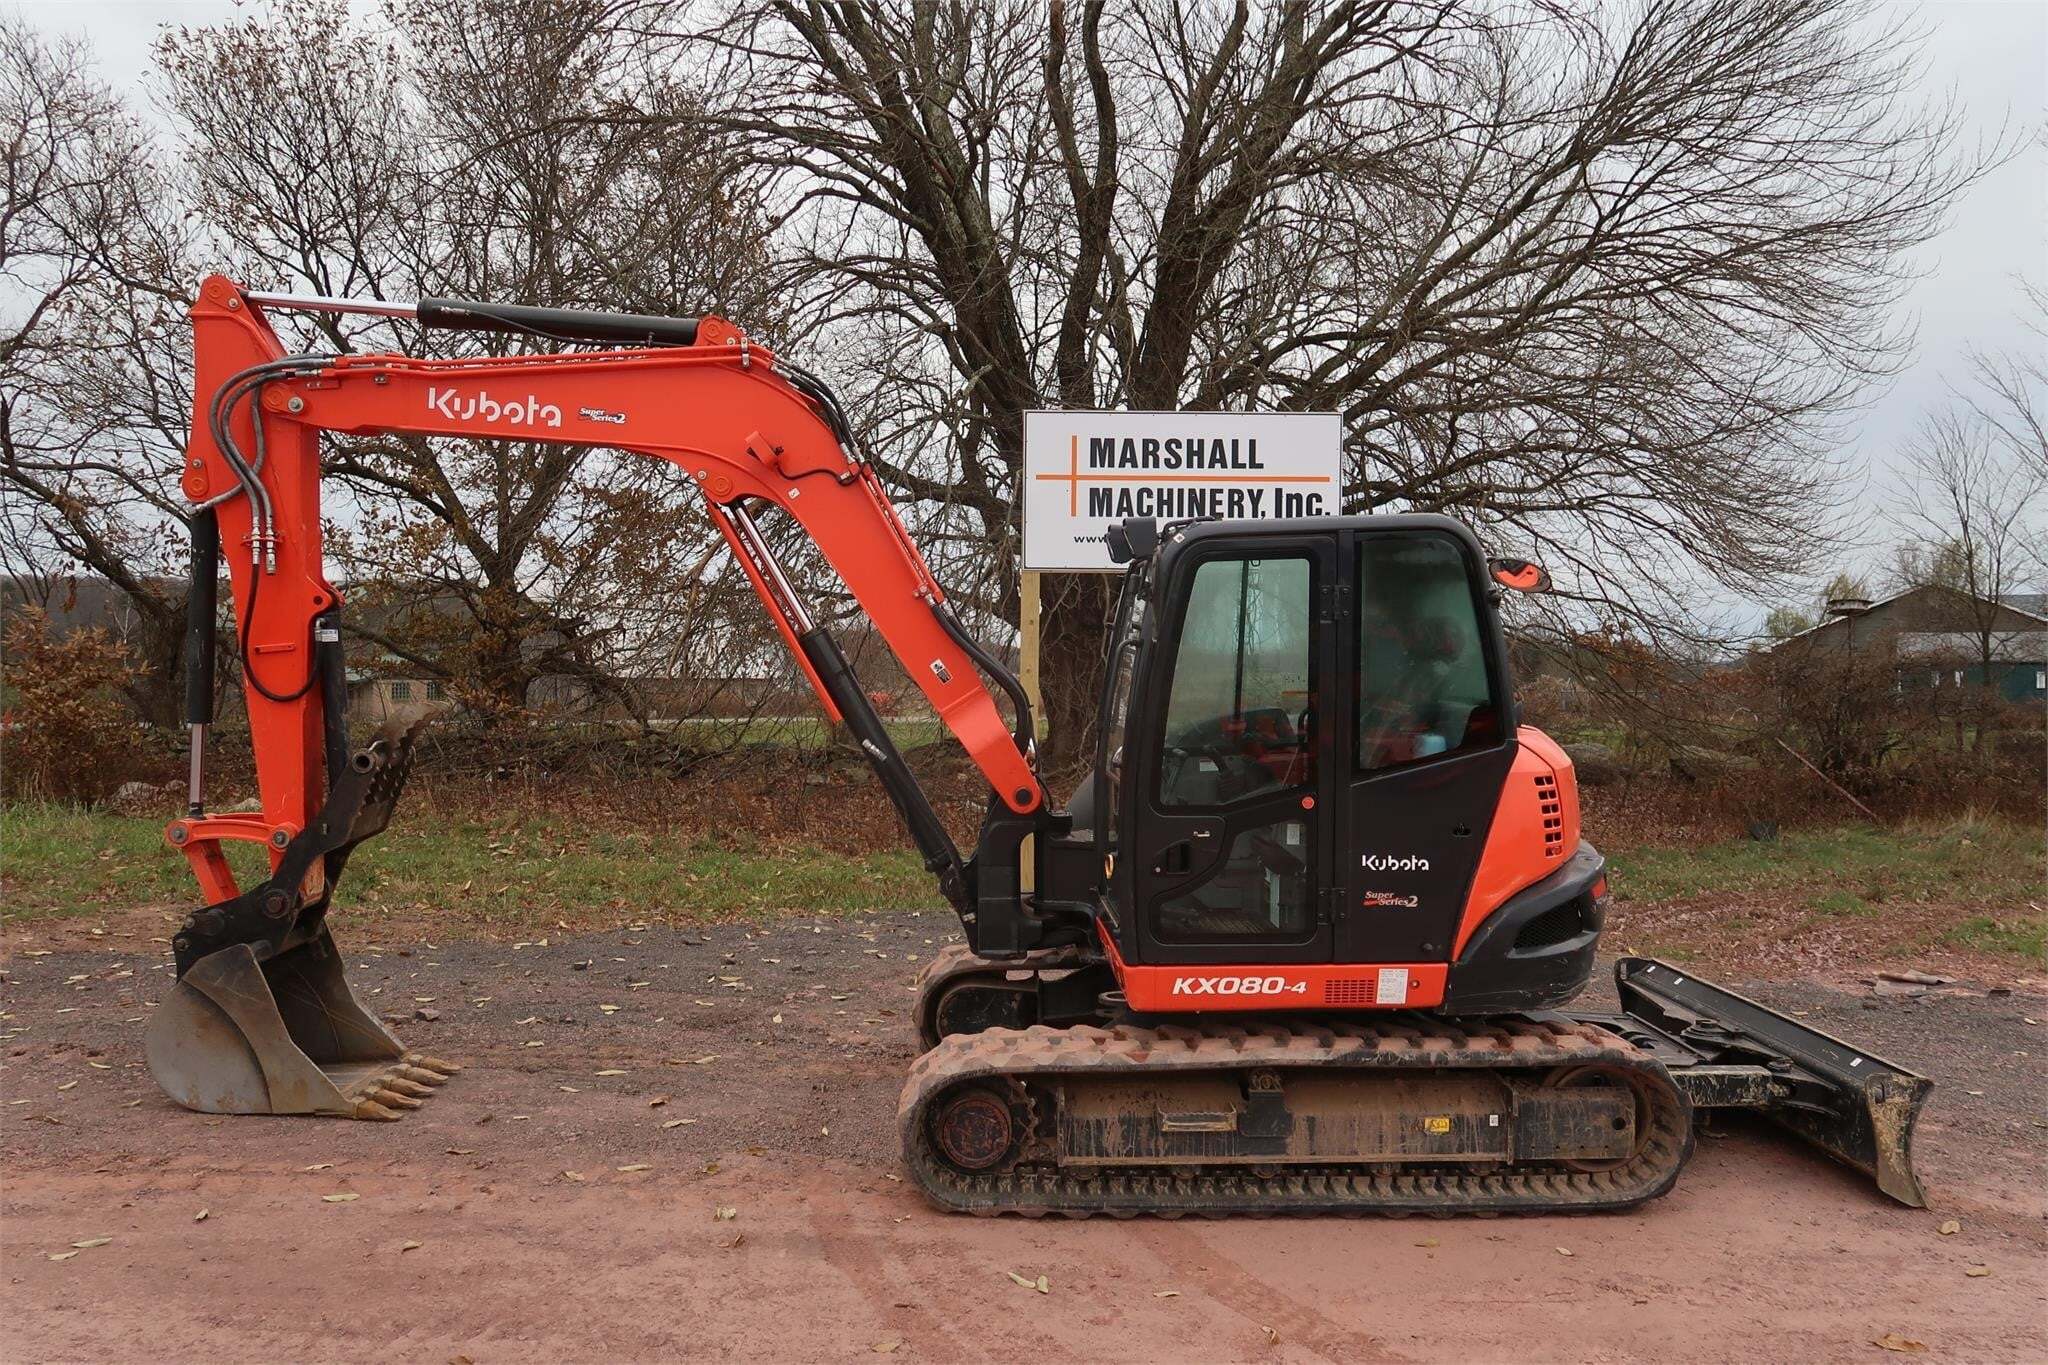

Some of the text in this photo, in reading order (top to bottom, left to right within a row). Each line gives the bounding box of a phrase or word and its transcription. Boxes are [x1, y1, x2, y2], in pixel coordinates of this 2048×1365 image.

[427, 387, 562, 427] Kubota
[1089, 438, 1264, 469] MARSHALL
[1089, 487, 1331, 519] MACHINERY, Inc.
[1361, 855, 1430, 871] Kubota
[1364, 891, 1395, 900] Super
[1172, 977, 1307, 995] KX080-4
